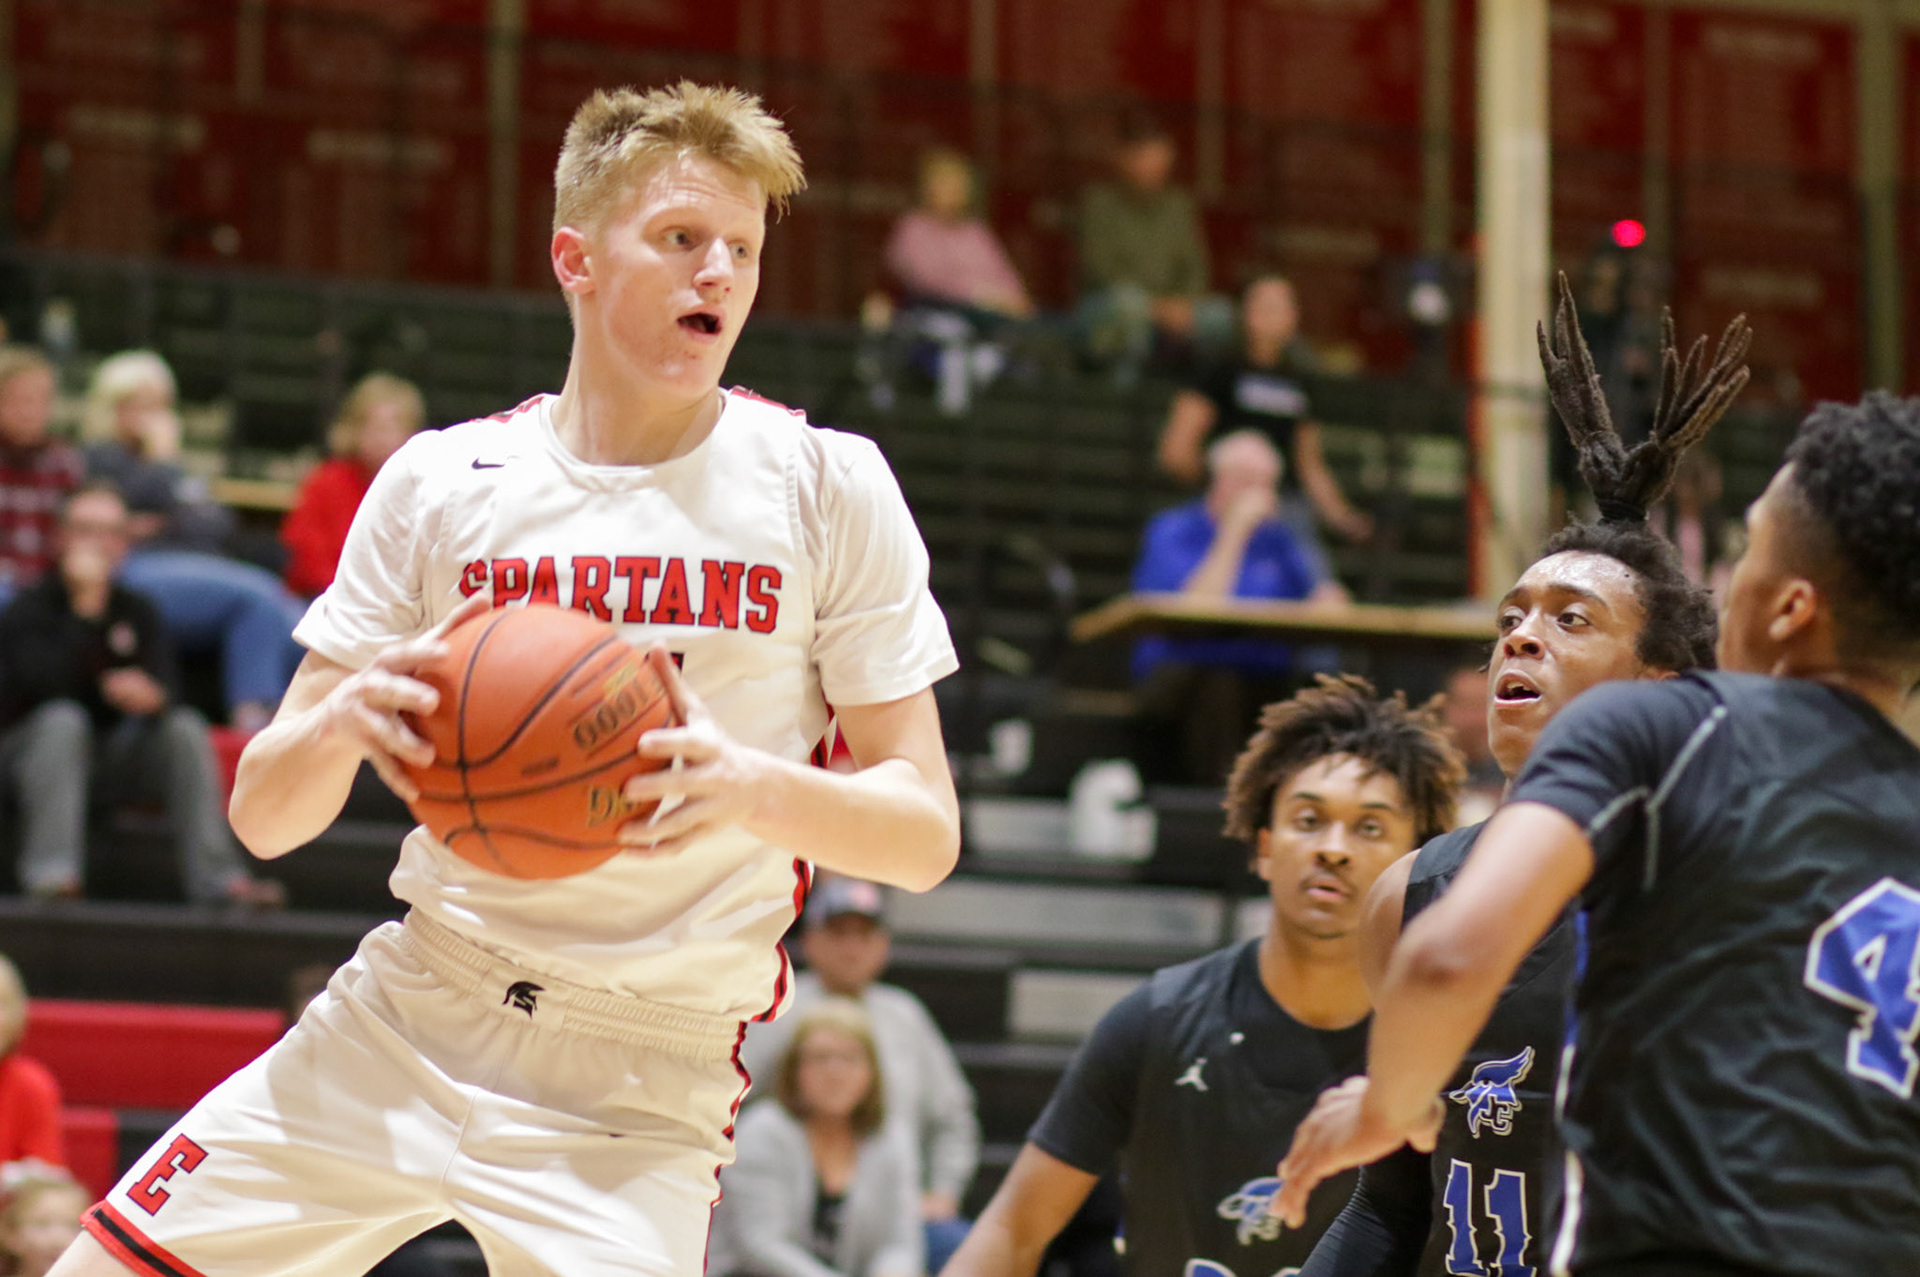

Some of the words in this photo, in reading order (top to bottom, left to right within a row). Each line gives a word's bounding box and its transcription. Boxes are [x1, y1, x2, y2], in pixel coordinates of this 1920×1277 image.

[459, 555, 782, 634] SPARTANS
[1803, 876, 1920, 1099] 4
[126, 1132, 209, 1217] E
[1443, 1158, 1537, 1277] 11
